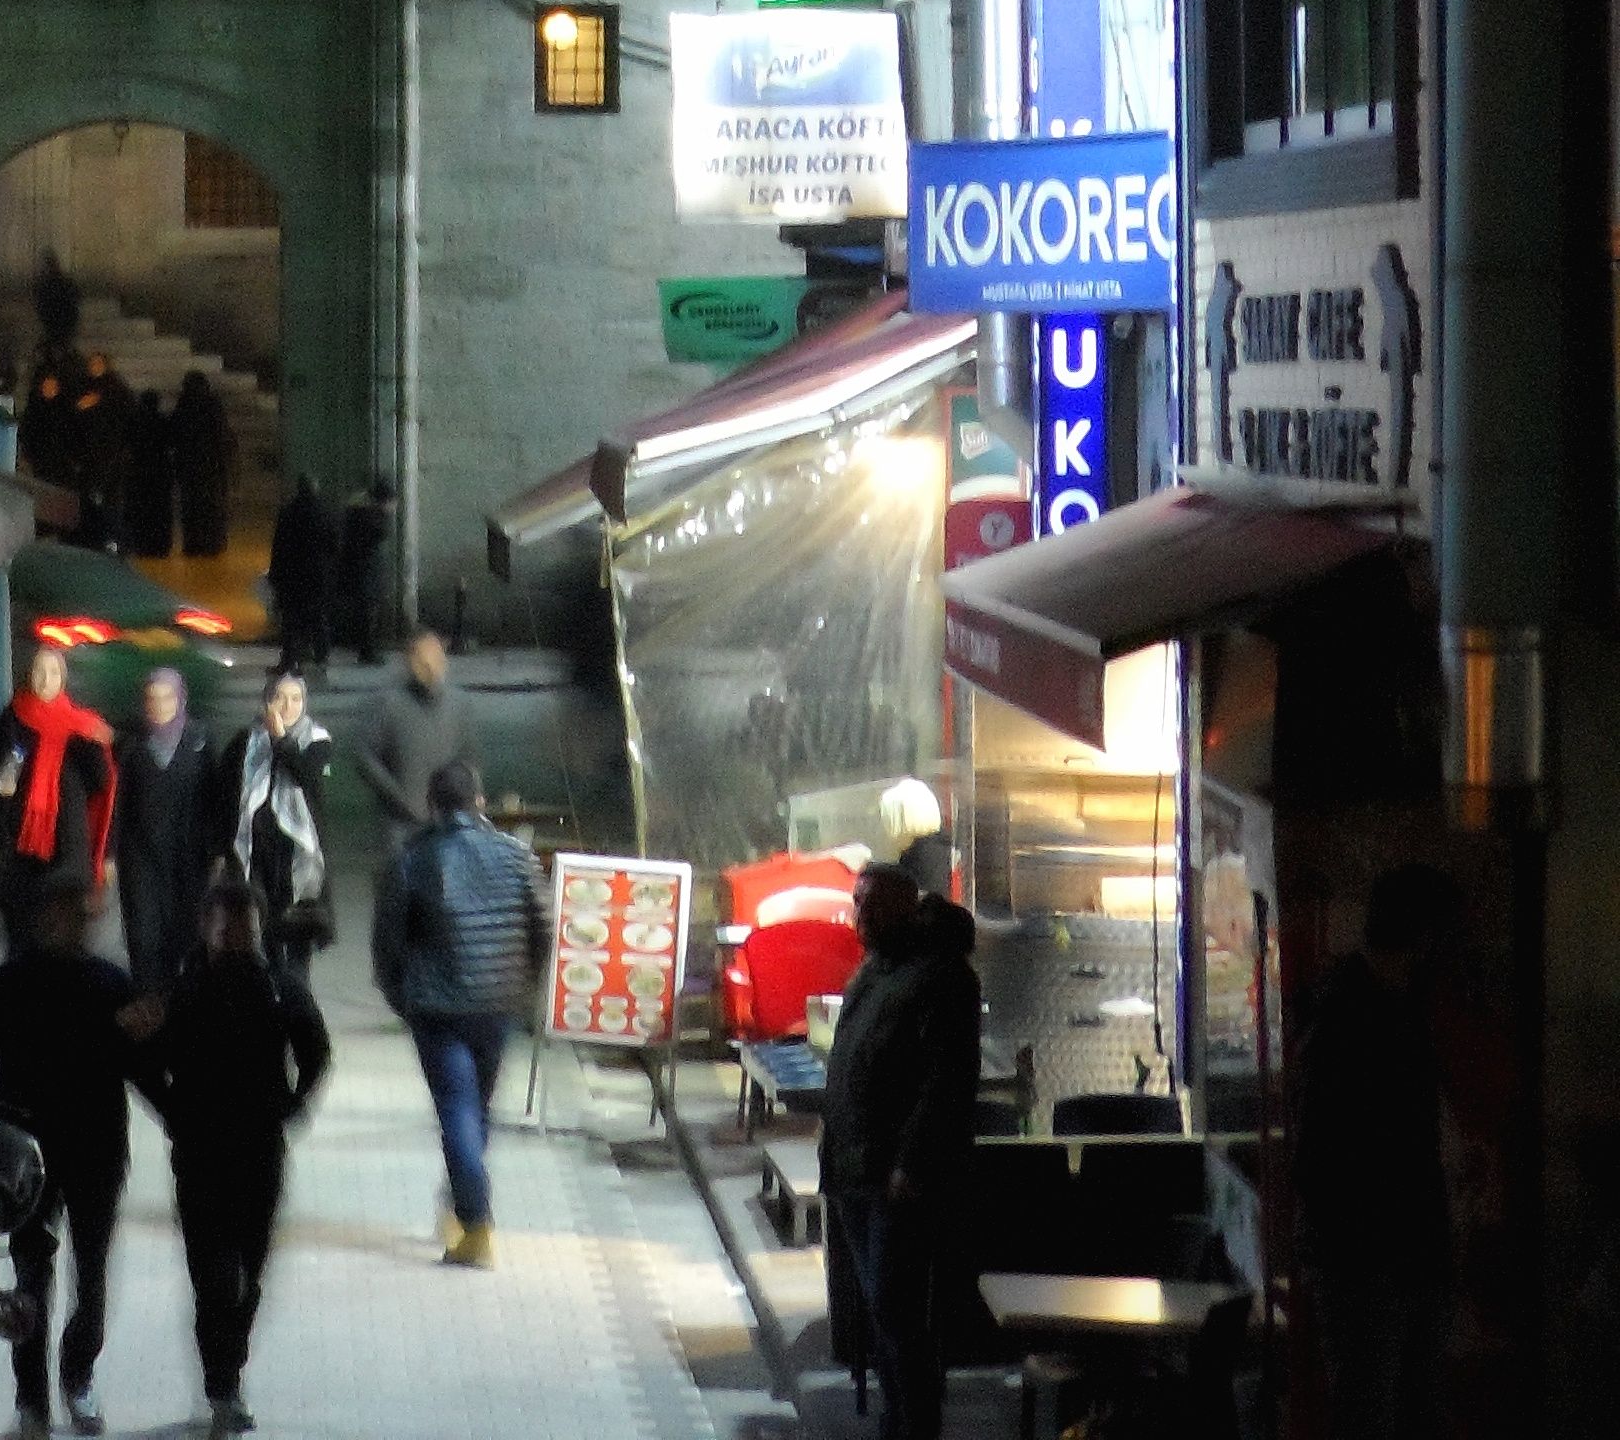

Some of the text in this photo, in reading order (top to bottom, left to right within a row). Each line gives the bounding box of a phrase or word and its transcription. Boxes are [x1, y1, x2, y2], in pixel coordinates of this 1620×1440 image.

[819, 111, 895, 141] KÖFT
[749, 181, 854, 206] İSA USTA
